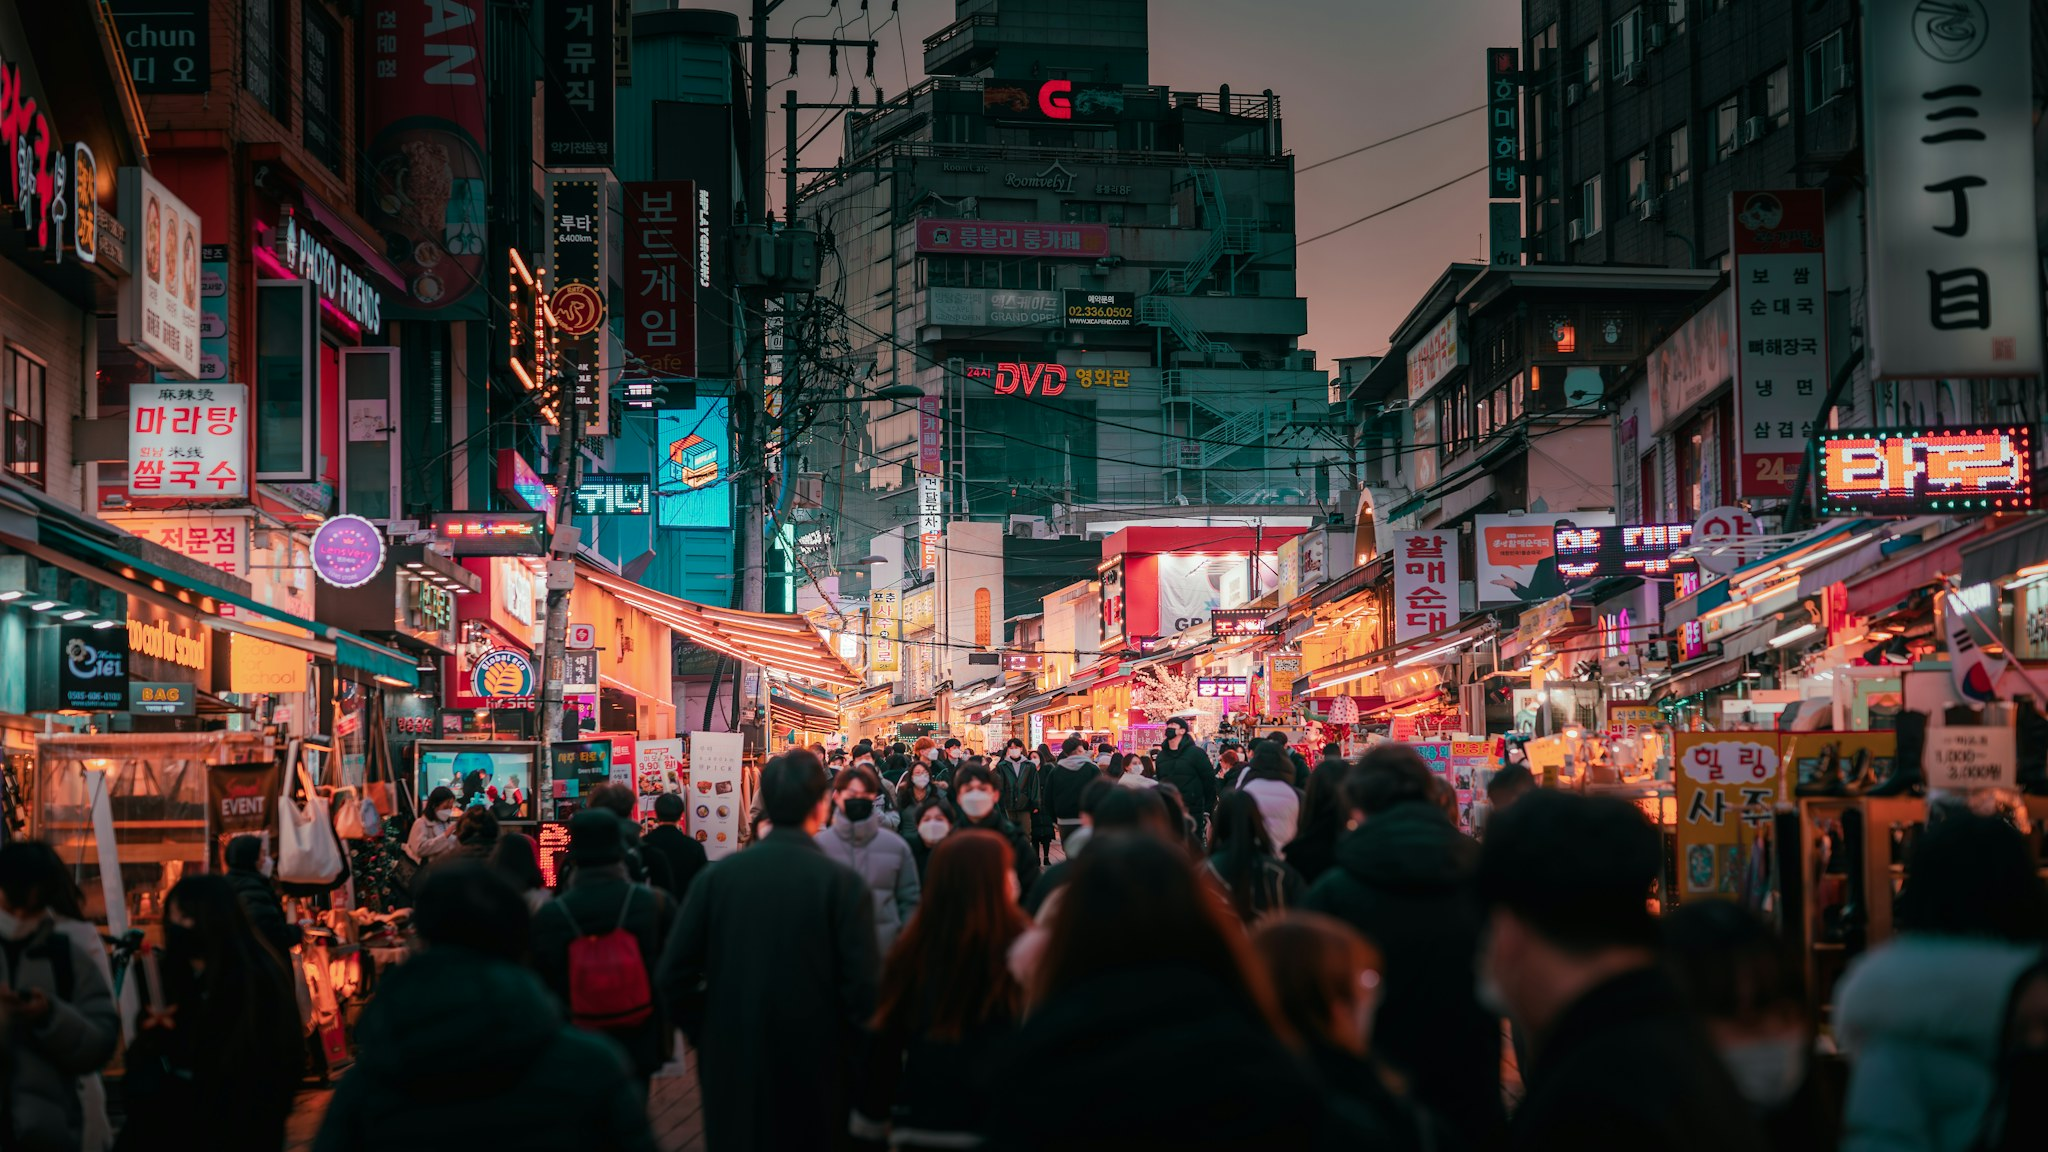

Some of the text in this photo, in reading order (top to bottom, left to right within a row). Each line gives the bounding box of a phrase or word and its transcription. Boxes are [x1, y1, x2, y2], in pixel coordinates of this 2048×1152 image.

[126, 25, 196, 48] chun
[1494, 78, 1518, 192] 호미화방
[1922, 85, 1990, 331] 三丁目
[560, 215, 592, 232] 루타
[960, 227, 1080, 250] 룸블리 룸카페
[299, 228, 380, 336] PHOTO FRIENDS
[637, 191, 678, 347] 보드게임
[991, 312, 1060, 324] GRAND OPEN
[1068, 306, 1133, 318] 02.336.0502
[1750, 298, 1815, 316] 순대국
[994, 362, 1068, 398] DVD
[1075, 368, 1130, 389] 영화관
[135, 406, 238, 436] 마라탕
[133, 460, 238, 490] 쌀국수
[159, 527, 236, 554] 전문점
[1405, 535, 1448, 650] 할매순대
[481, 654, 526, 673] global eco
[142, 688, 180, 701] BAG
[1695, 748, 1766, 780] 힐링
[221, 796, 266, 816] EVENT
[1686, 787, 1775, 828] 사주
